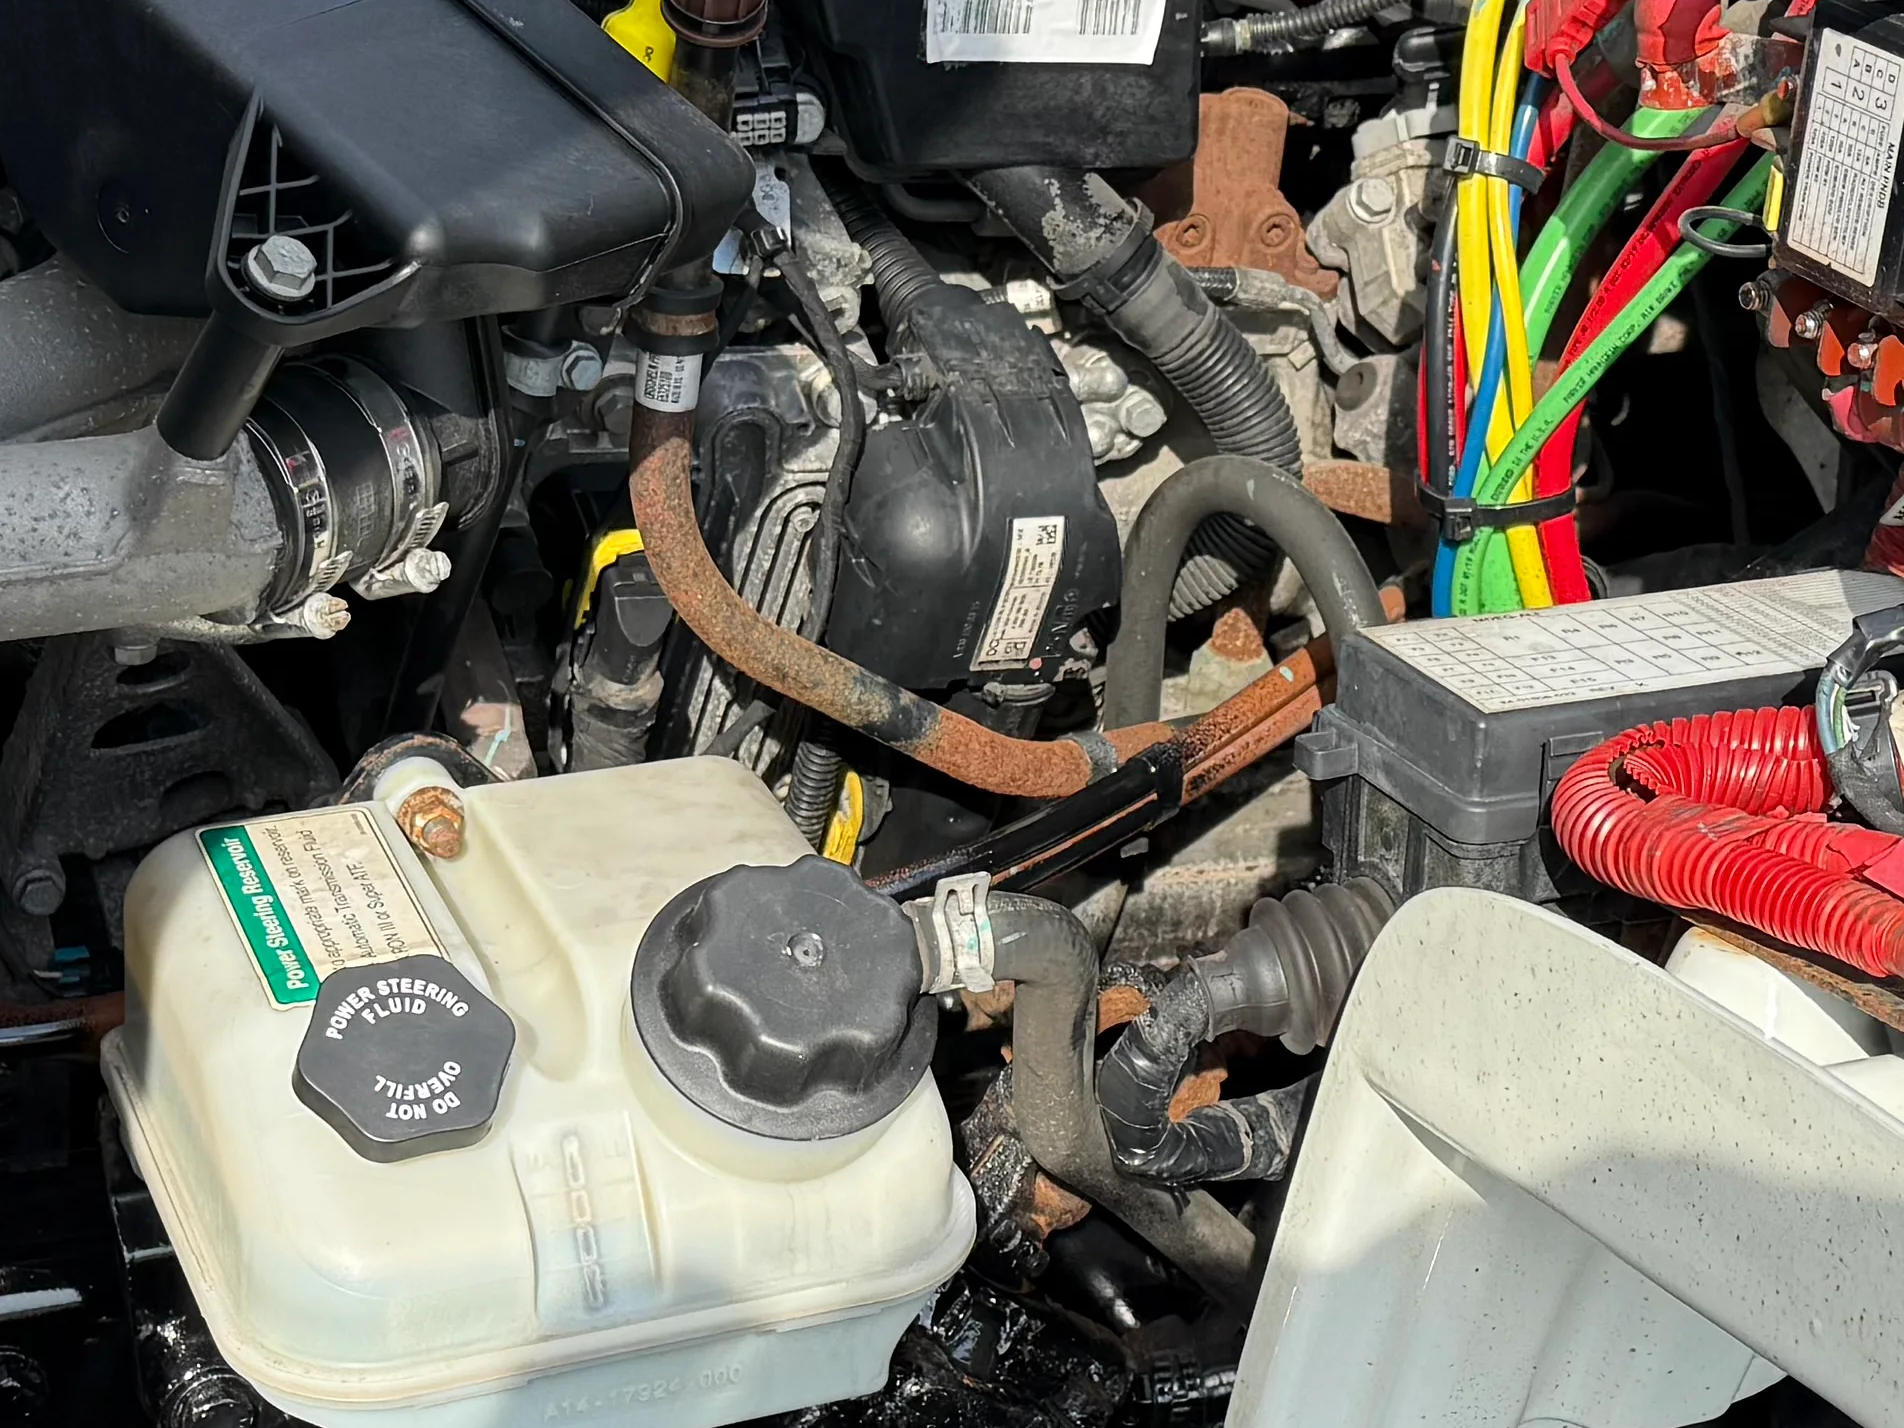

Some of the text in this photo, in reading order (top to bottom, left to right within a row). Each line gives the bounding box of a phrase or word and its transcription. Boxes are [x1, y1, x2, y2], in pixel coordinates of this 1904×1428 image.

[1830, 80, 1842, 91] 1
[1851, 85, 1865, 102] 2
[1875, 95, 1888, 111] 3
[1884, 142, 1896, 174] MAIN
[346, 860, 370, 887] ATF.
[292, 878, 312, 906] mark
[296, 828, 377, 960] Automatic Transmission Fluid
[361, 880, 386, 911] Super
[221, 837, 310, 990] Power Steering Reservoir
[305, 905, 342, 960] appropriate
[326, 978, 470, 1040] POWER STEERING
[361, 997, 427, 1025] FLUID
[374, 1060, 461, 1101] OVERFILL
[385, 1091, 461, 1121] DO NOT
